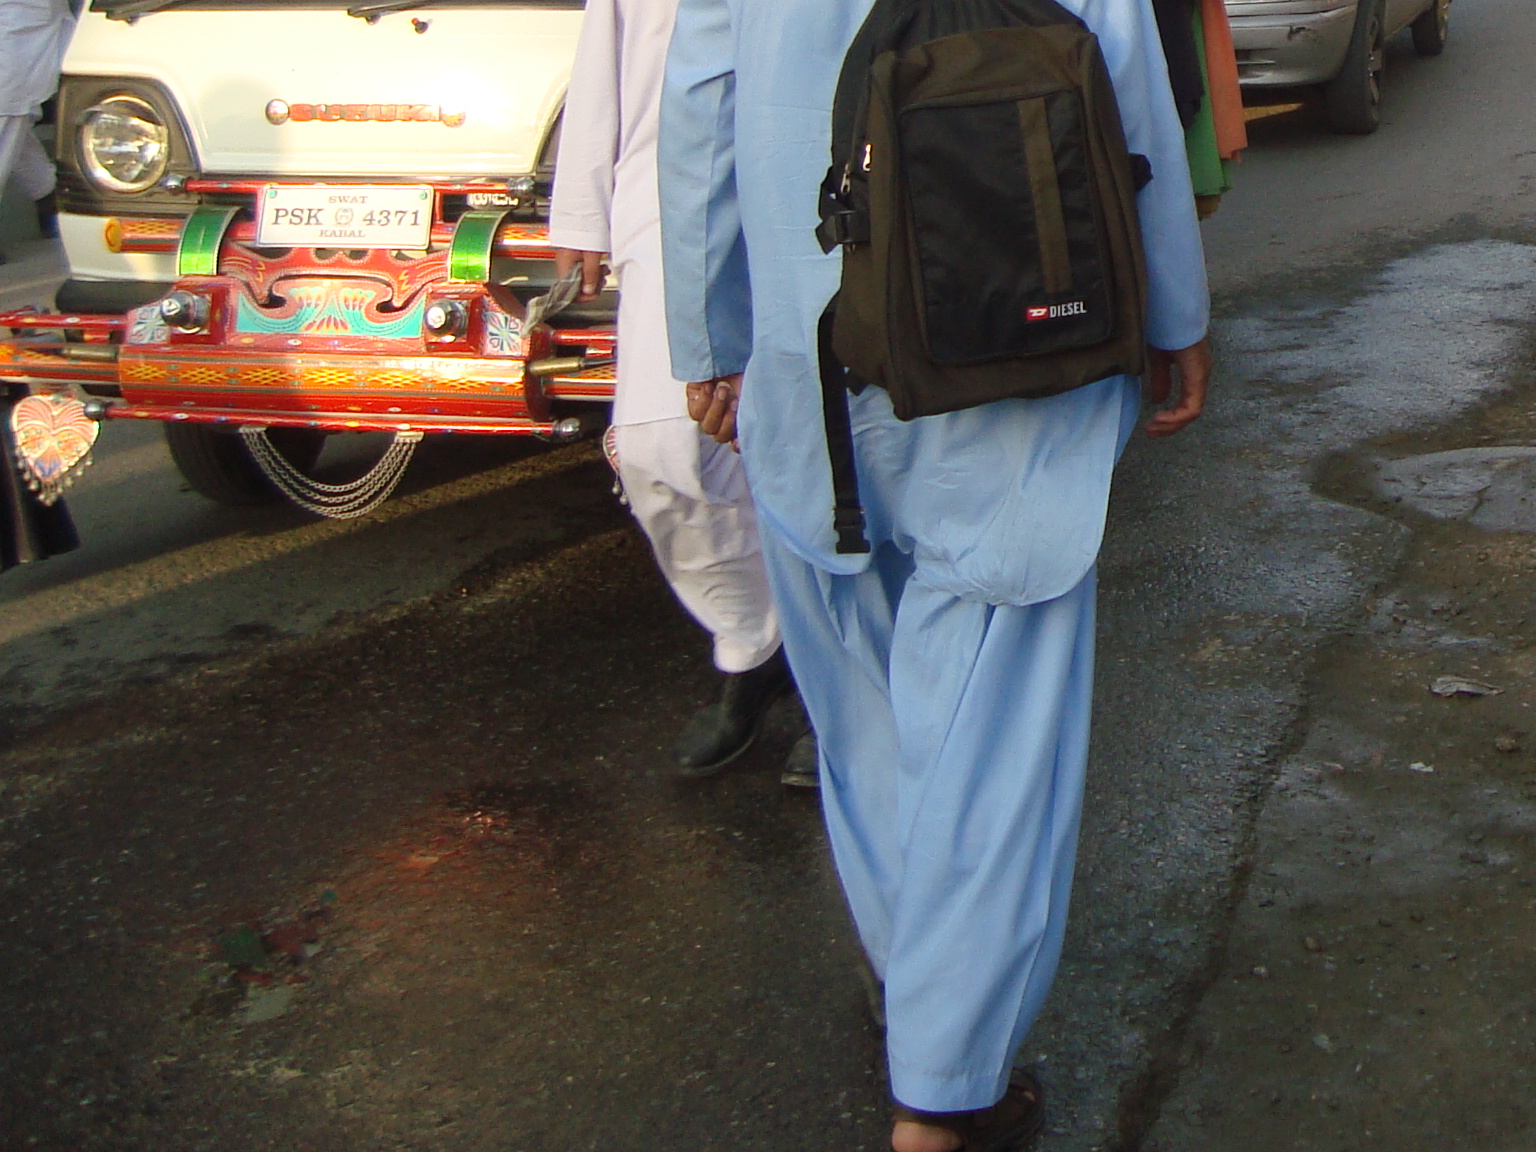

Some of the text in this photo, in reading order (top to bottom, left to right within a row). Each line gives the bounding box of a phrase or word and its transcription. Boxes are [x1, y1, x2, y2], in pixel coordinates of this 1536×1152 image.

[289, 103, 441, 123] SUZUKI
[328, 195, 369, 205] SWAT
[271, 208, 422, 226] PSK 4371
[318, 229, 367, 238] KABAL
[1048, 301, 1087, 318] DIESEL
